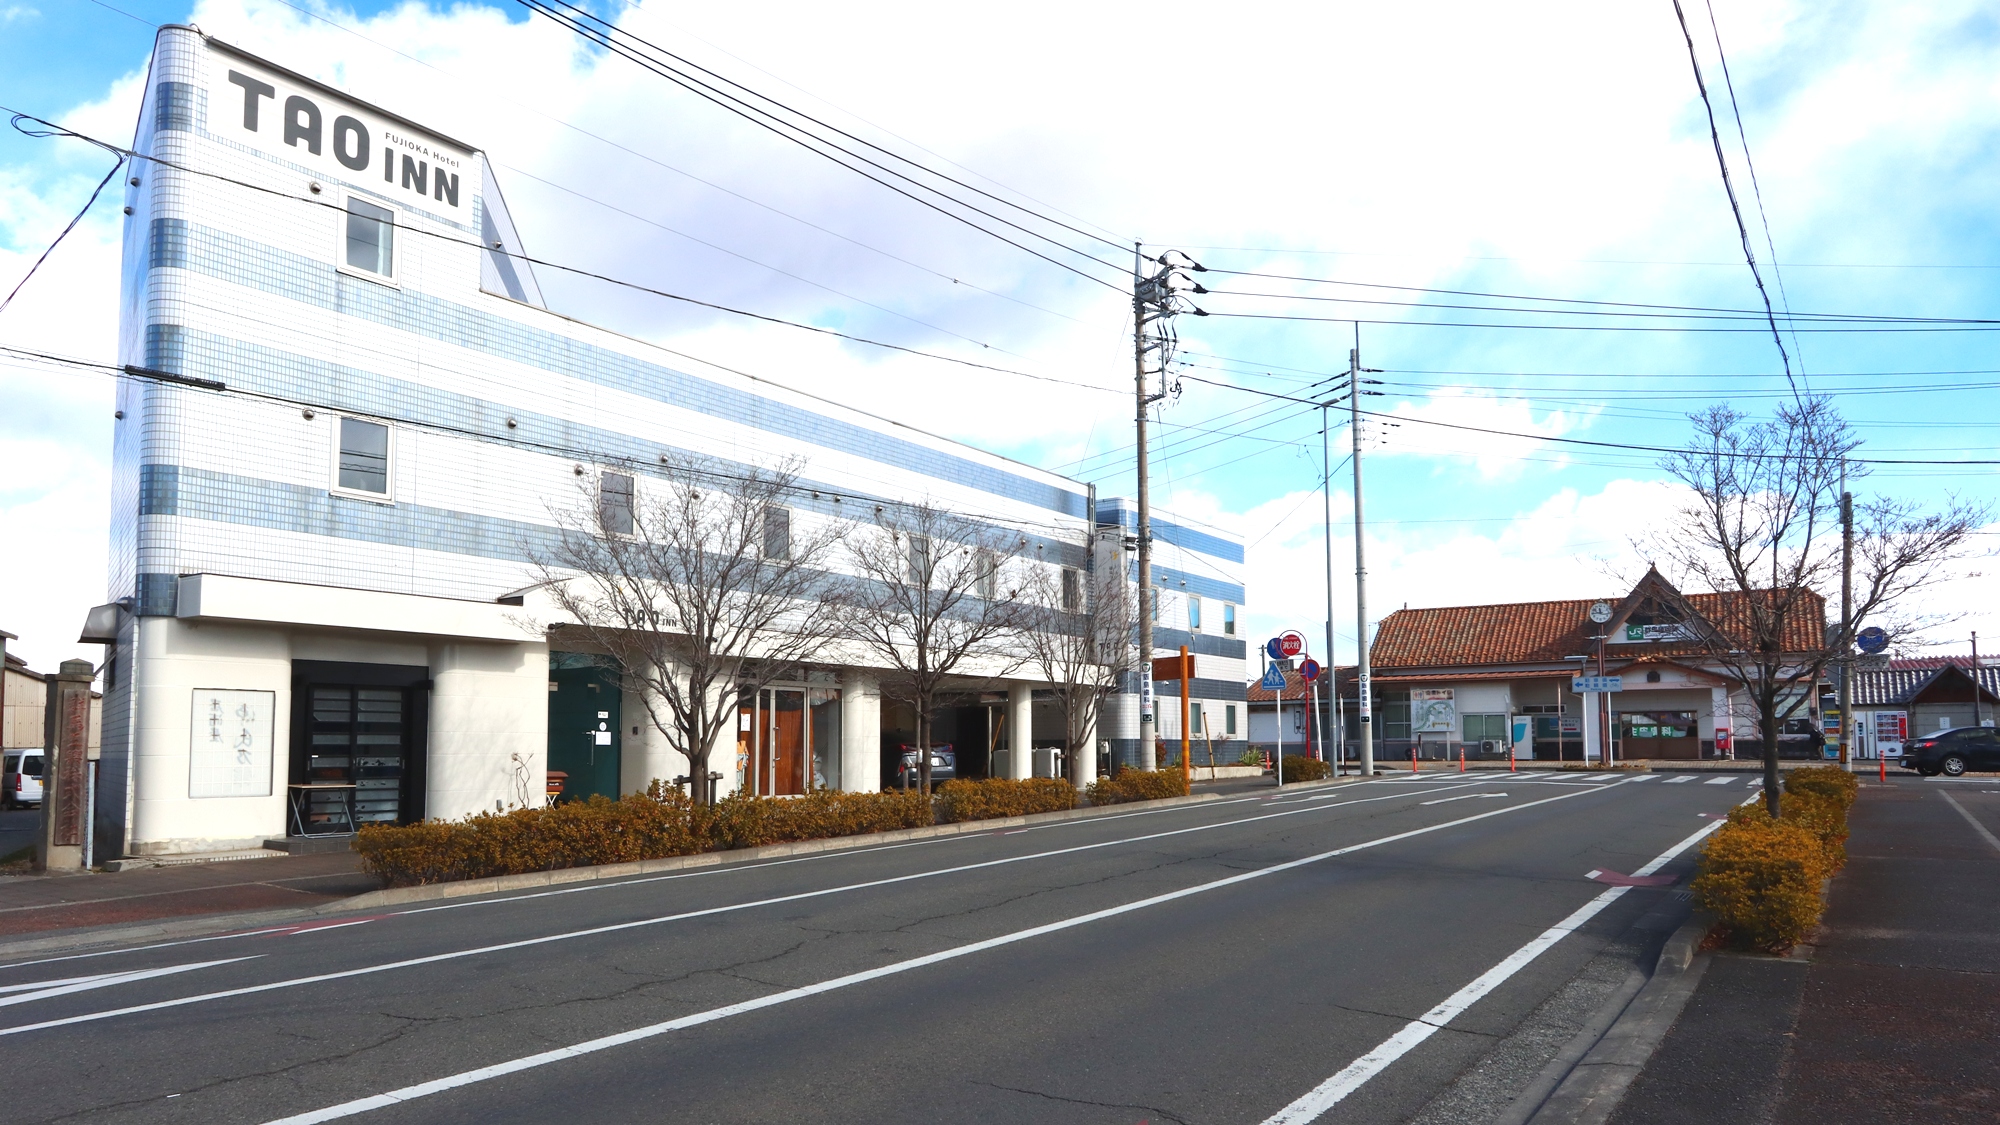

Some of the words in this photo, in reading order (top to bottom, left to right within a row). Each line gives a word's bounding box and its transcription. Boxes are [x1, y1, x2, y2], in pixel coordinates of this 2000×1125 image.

[228, 69, 371, 172] TAO
[384, 131, 430, 157] FUJIOKA
[432, 150, 460, 169] Hotel
[384, 148, 460, 208] INN
[662, 618, 677, 628] INN
[1629, 627, 1643, 635] JR
[1282, 641, 1300, 650] 消火栓
